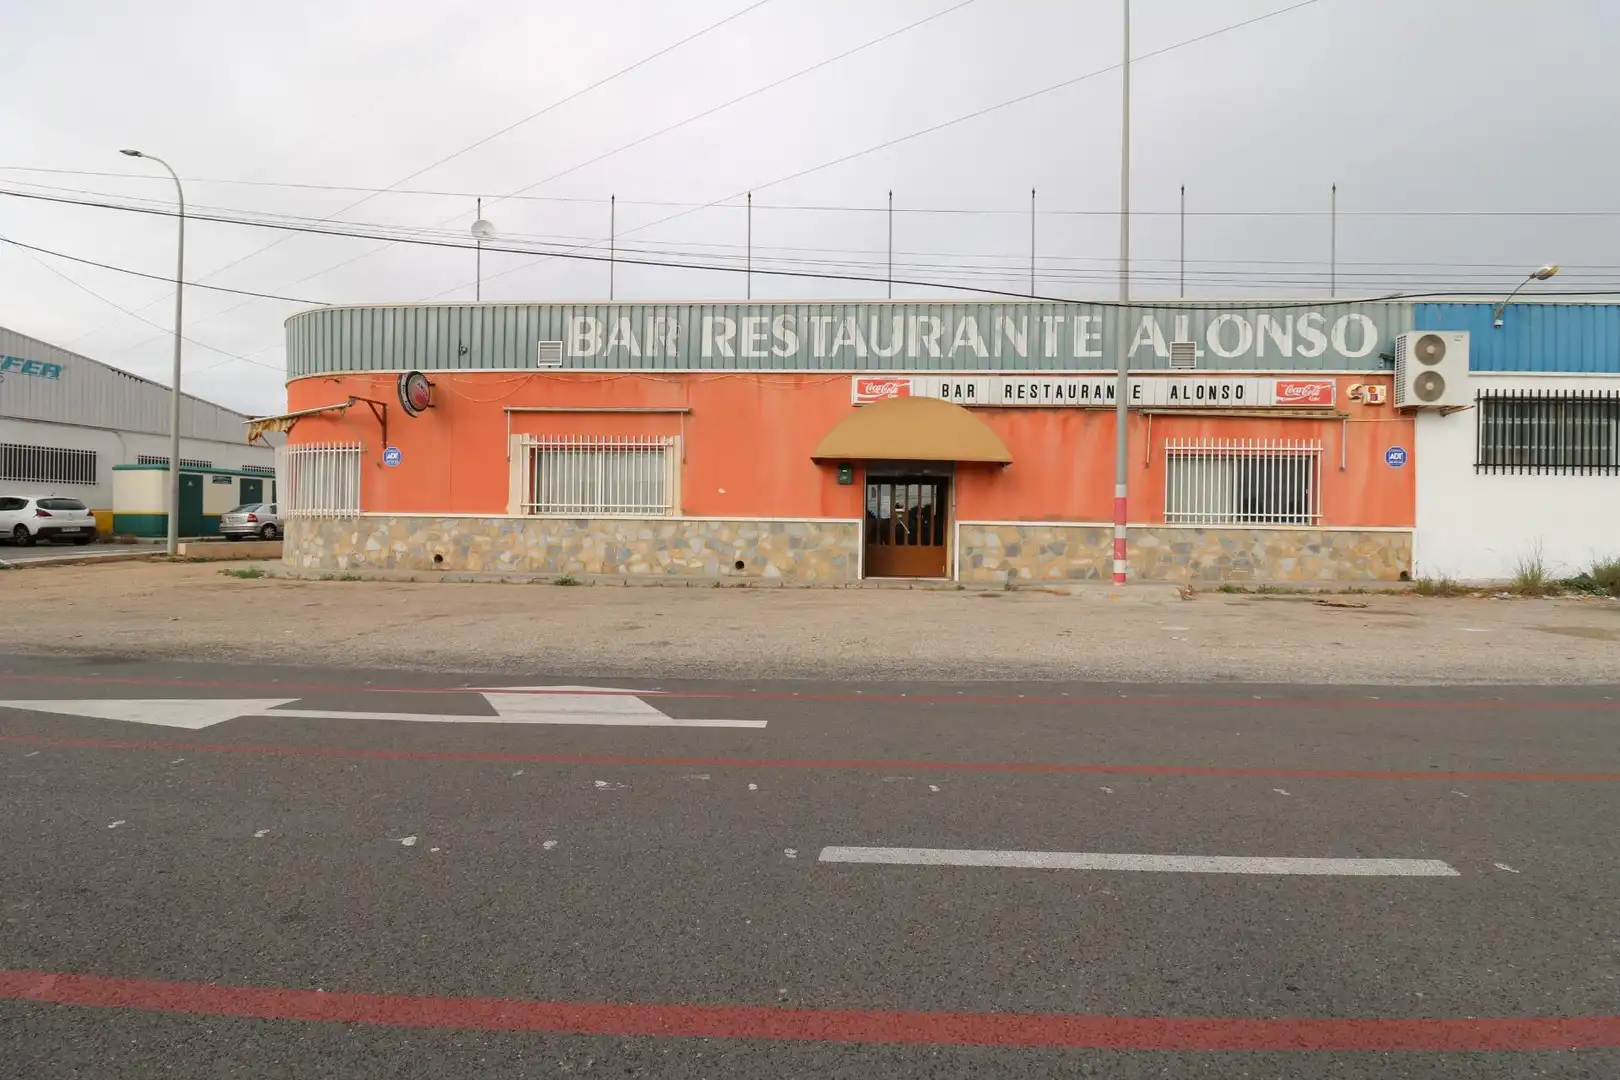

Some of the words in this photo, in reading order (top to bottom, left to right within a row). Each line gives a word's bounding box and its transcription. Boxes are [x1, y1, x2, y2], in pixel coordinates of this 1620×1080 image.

[567, 316, 681, 357] BAR
[700, 315, 1103, 358] RESTAURANTE
[1128, 312, 1378, 358] ALONSO
[0, 355, 62, 380] FER
[865, 382, 899, 395] Coca-Cola
[941, 384, 975, 398] BAR
[1004, 384, 1141, 399] RESTAURANE
[1170, 385, 1244, 400] ALONSO
[1285, 384, 1321, 398] Coca-Cola
[1389, 452, 1403, 460] ADT
